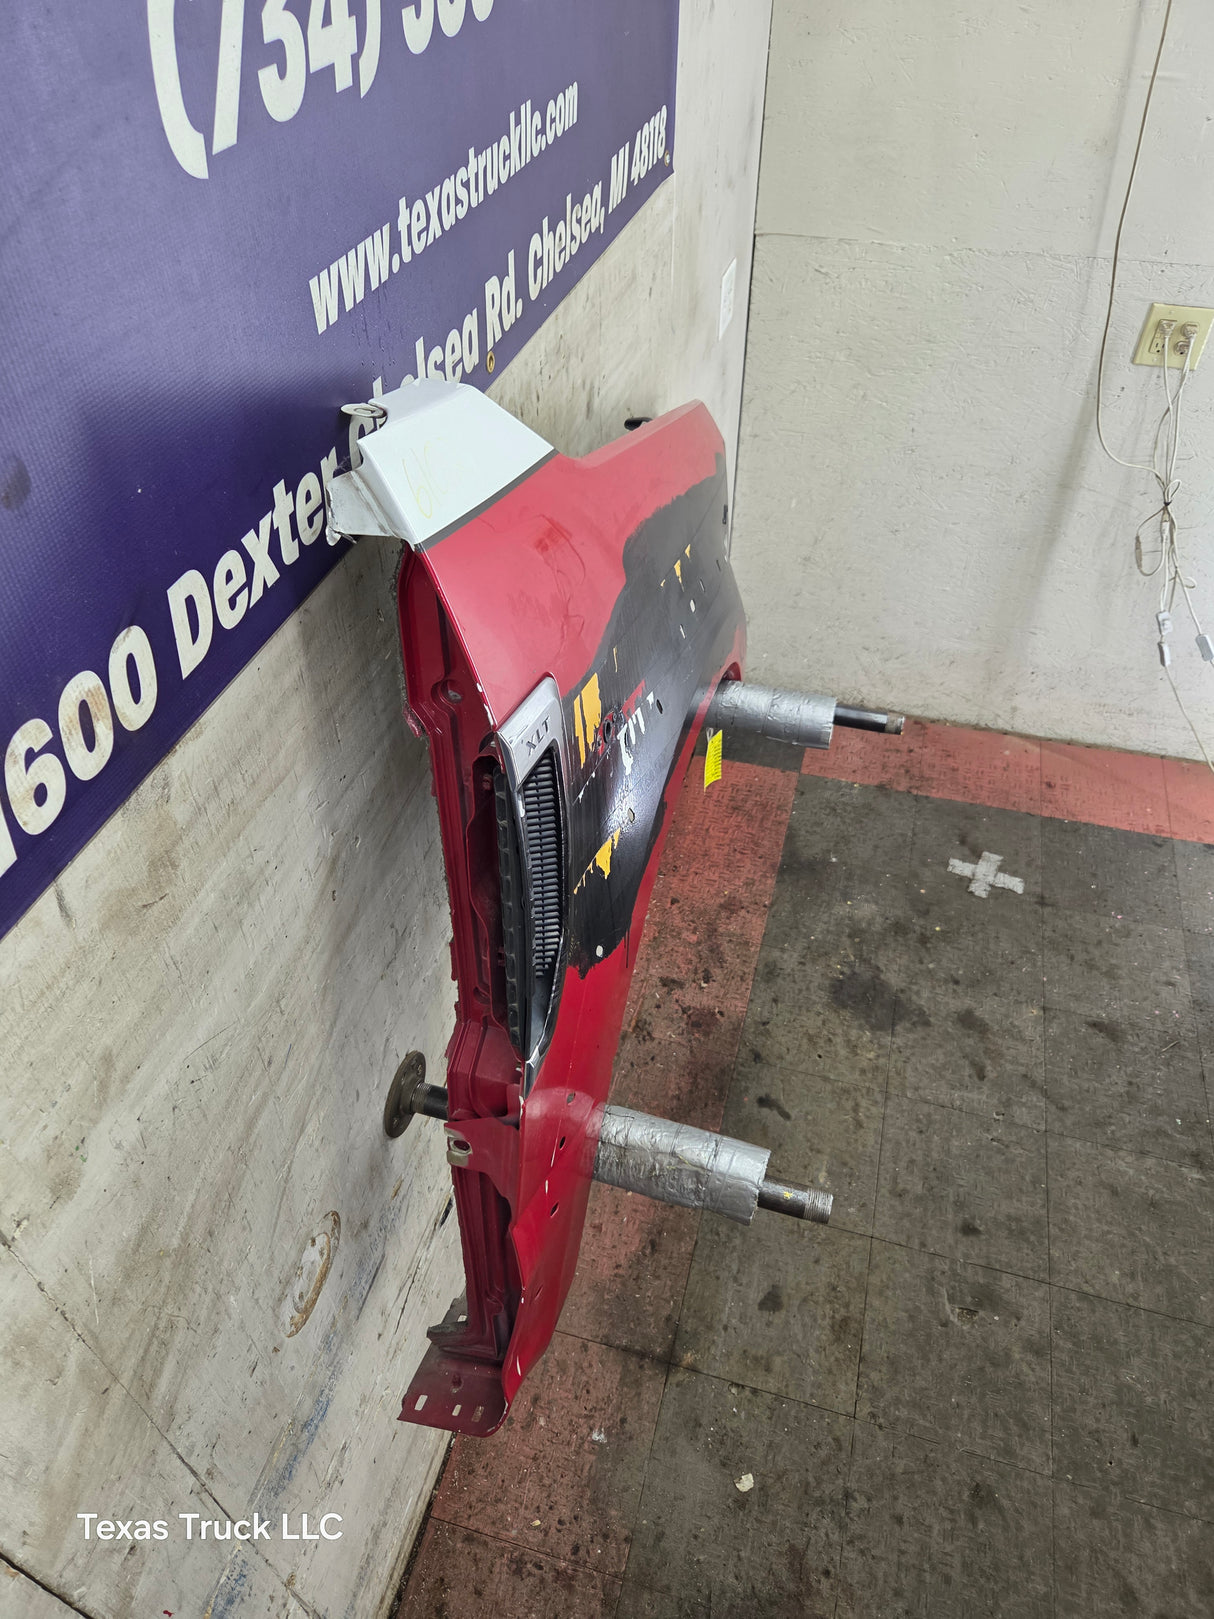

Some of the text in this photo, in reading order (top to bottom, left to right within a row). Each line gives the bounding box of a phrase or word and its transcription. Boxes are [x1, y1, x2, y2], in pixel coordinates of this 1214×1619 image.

[309, 81, 578, 335] www.texastruckllc.com
[0, 625, 158, 878] 600
[485, 249, 523, 352] Rd.
[528, 180, 605, 301] Chelsea,
[608, 141, 630, 215] MI
[631, 104, 668, 187] 48118
[526, 715, 550, 756] XLT
